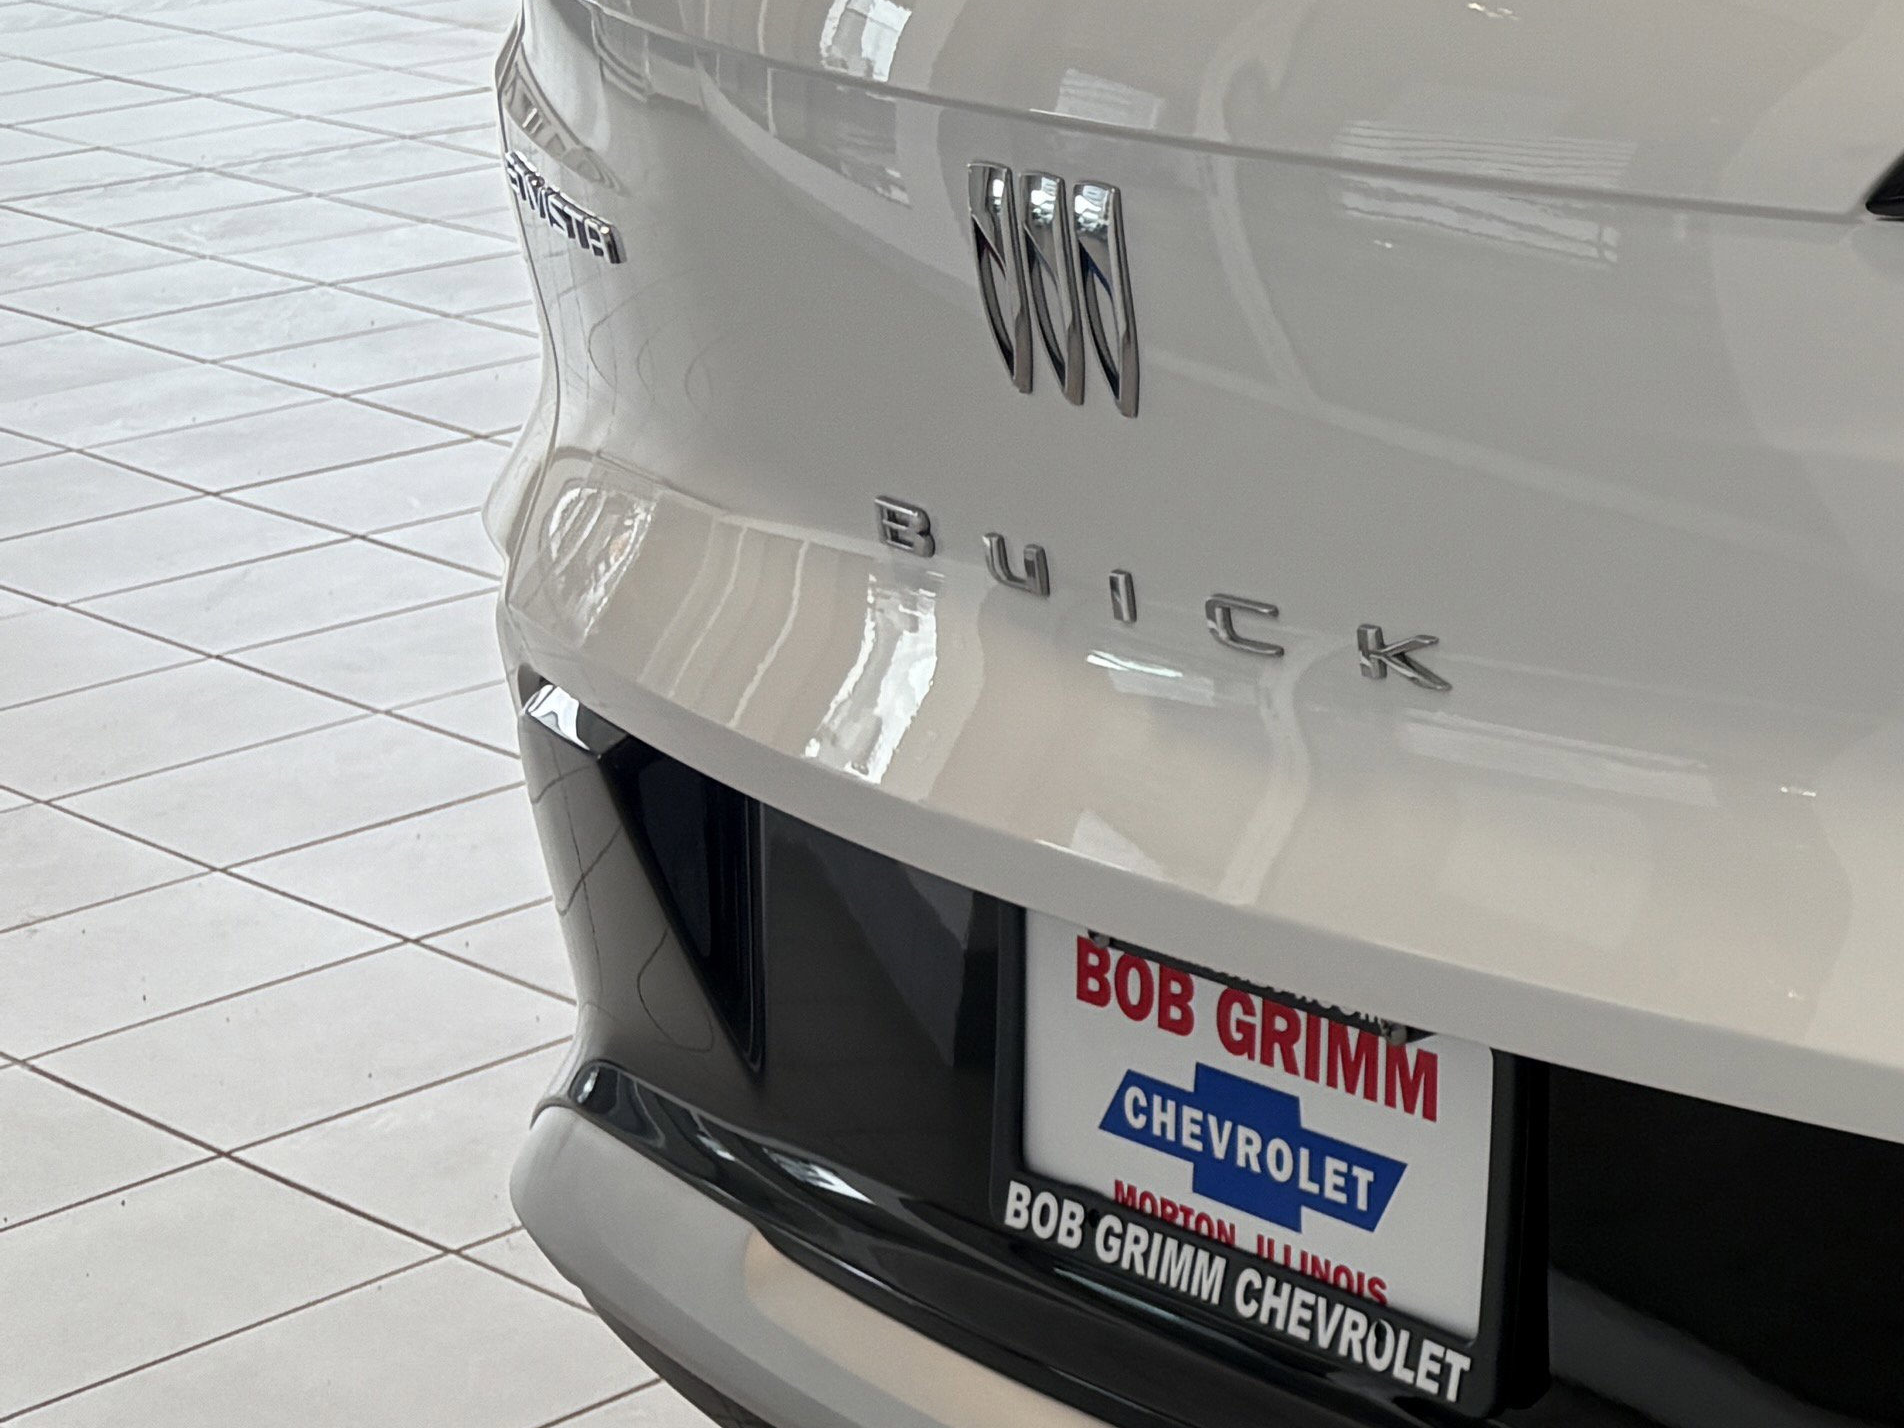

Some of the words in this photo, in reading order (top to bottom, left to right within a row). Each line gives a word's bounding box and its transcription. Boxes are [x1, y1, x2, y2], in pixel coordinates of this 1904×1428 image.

[874, 494, 1453, 692] BUICK
[1075, 935, 1195, 1037] BOB
[1216, 986, 1439, 1123] GRIMM
[1123, 1086, 1375, 1212] CHEVROLET
[1004, 1179, 1086, 1249] BOB
[1094, 1214, 1227, 1305] GRIMM
[1235, 1267, 1472, 1403] CHEVROLET
